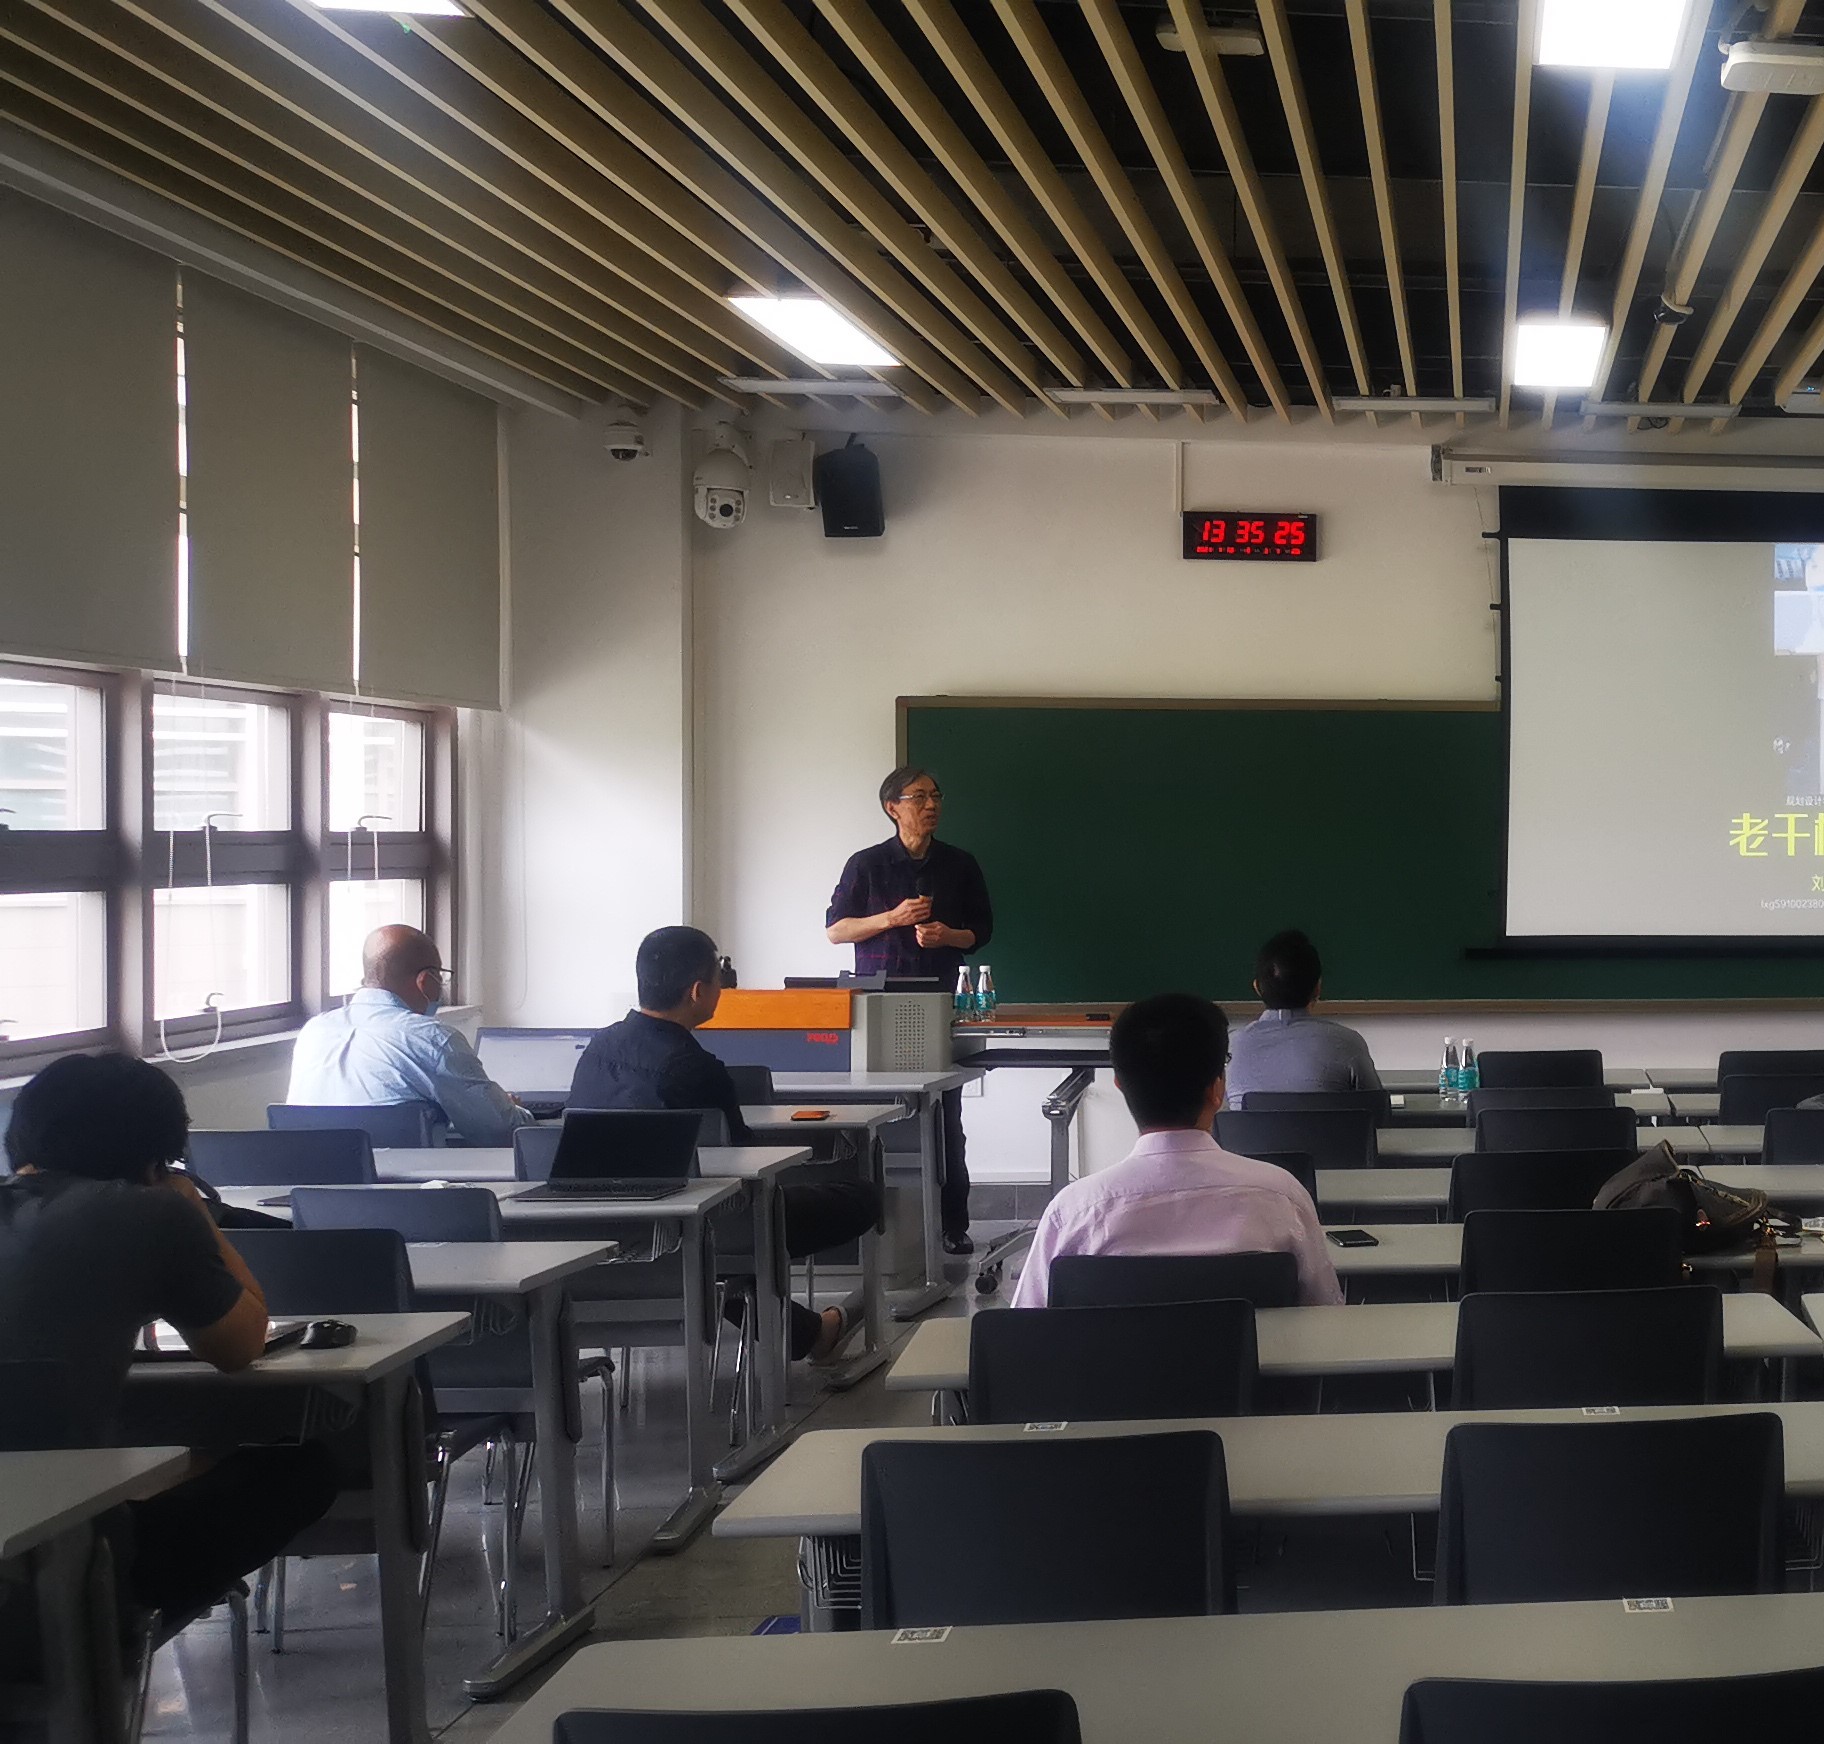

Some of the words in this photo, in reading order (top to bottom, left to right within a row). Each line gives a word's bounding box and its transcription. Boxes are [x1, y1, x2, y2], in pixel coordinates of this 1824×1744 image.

[1202, 520, 1226, 543] 13
[1235, 520, 1265, 543] 35
[1273, 521, 1305, 545] 25
